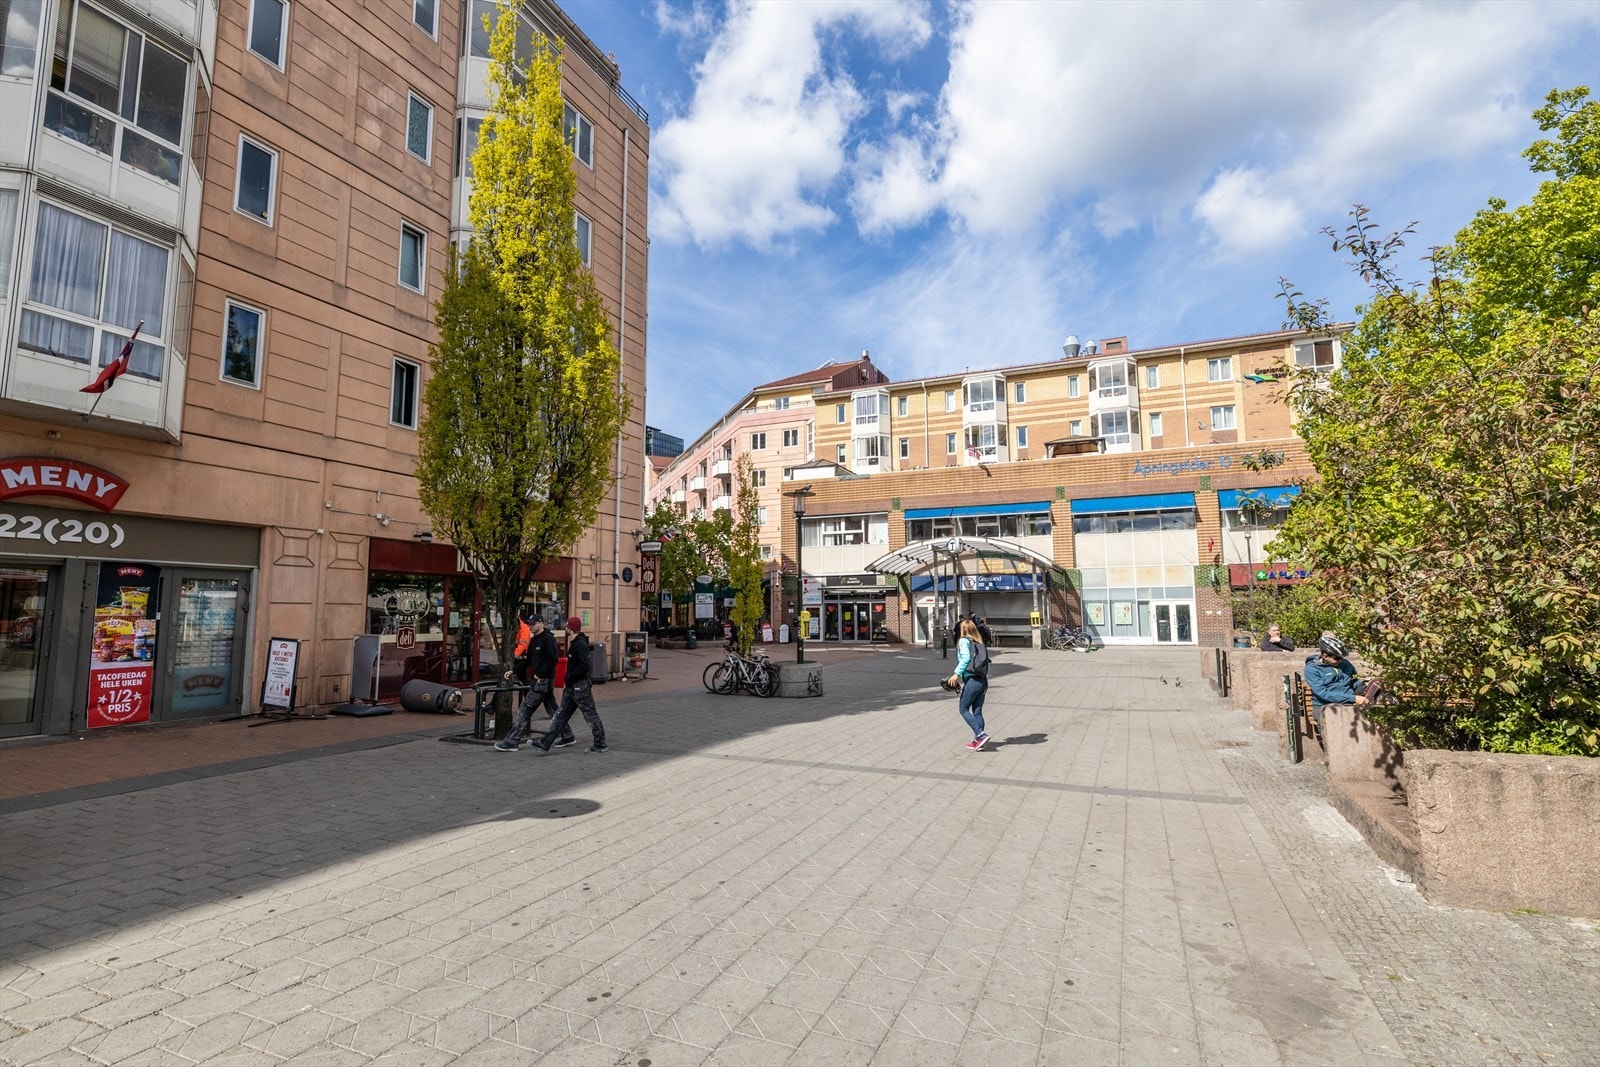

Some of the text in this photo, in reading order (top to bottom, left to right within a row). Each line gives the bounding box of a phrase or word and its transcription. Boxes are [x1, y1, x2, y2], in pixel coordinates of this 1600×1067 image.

[1217, 455, 1232, 469] 10
[1, 466, 118, 498] MENY
[0, 513, 125, 549] 22(20)
[642, 556, 655, 570] Deli
[641, 580, 655, 593] Luca
[396, 591, 420, 599] SINGLE
[395, 614, 419, 622] ESTATE
[400, 629, 413, 645] deli
[97, 671, 147, 681] TACOFREDAG
[100, 679, 143, 689] HELE UKEN
[109, 689, 132, 704] 1/2
[107, 702, 132, 714] PRIS
